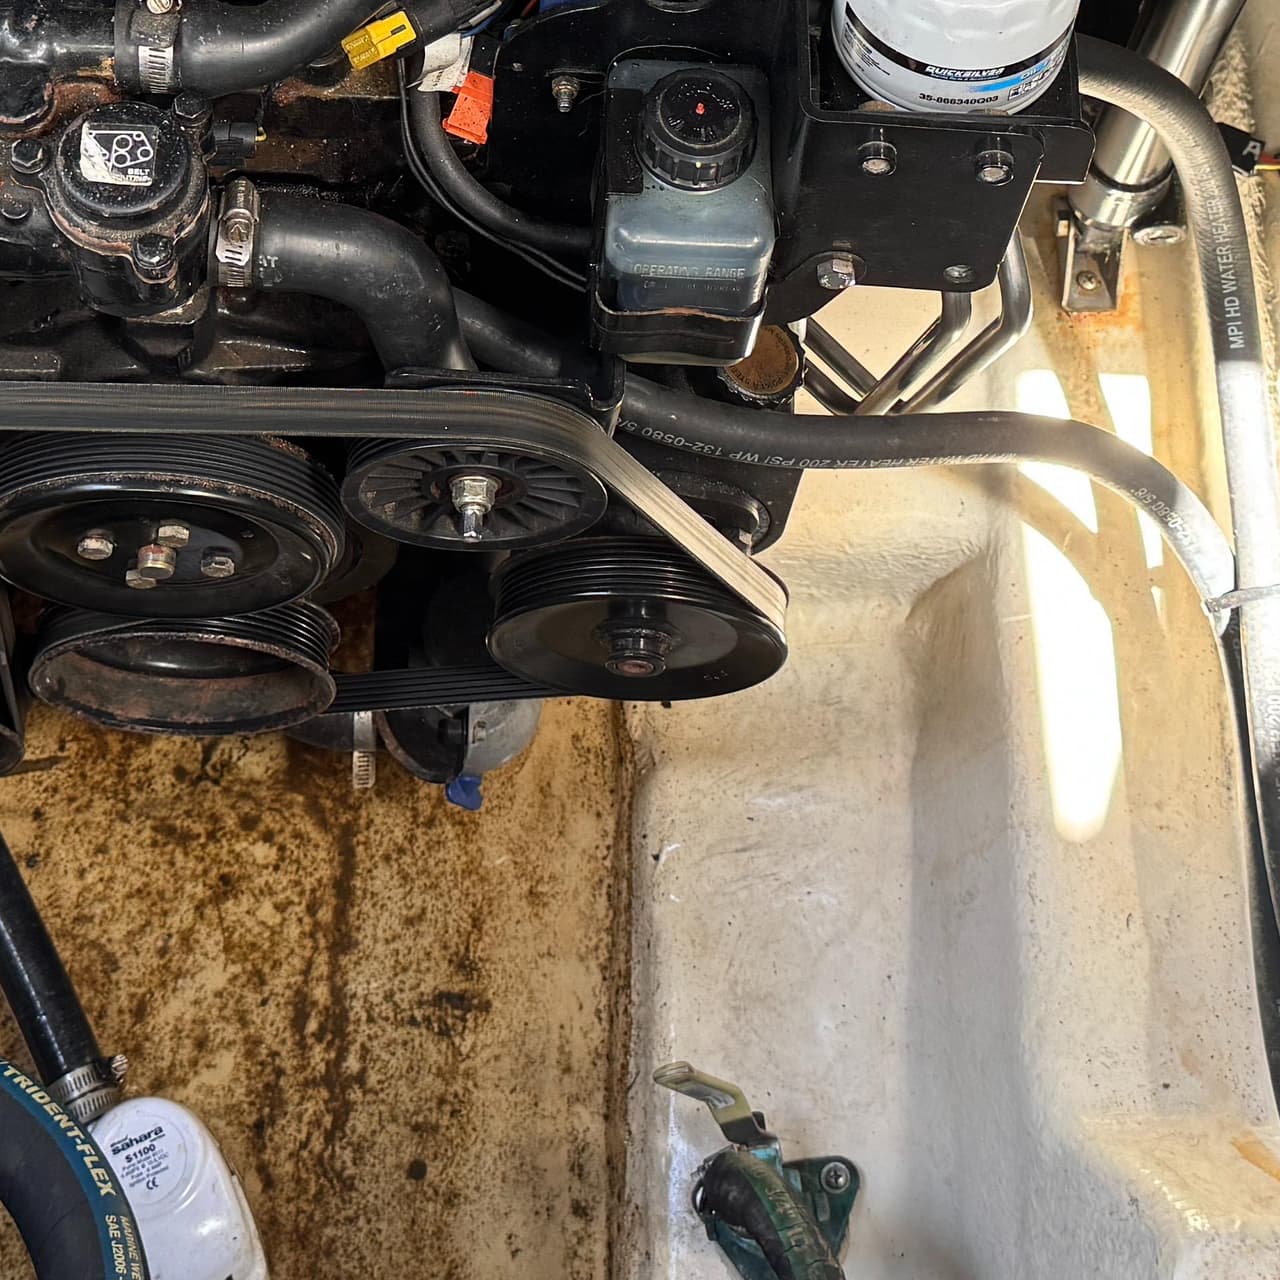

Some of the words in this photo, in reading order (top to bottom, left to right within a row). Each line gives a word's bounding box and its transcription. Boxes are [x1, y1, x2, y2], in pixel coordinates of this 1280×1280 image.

[924, 65, 1006, 78] QUICKSILVER
[1206, 196, 1229, 243] HEATER
[705, 267, 746, 279] RANGE
[1213, 243, 1239, 293] WATER
[1221, 294, 1242, 319] HD
[1225, 319, 1247, 350] MPI
[641, 425, 723, 452] 132-0580
[729, 450, 761, 464] WP
[767, 455, 795, 467] PSI
[3, 1061, 117, 1197] TRIDENT-FLEX
[110, 1125, 163, 1155] sahara
[124, 1142, 156, 1163] S1100
[104, 1213, 121, 1238] SAE
[119, 1214, 139, 1261] MARINE
[110, 1239, 127, 1274] J2006
